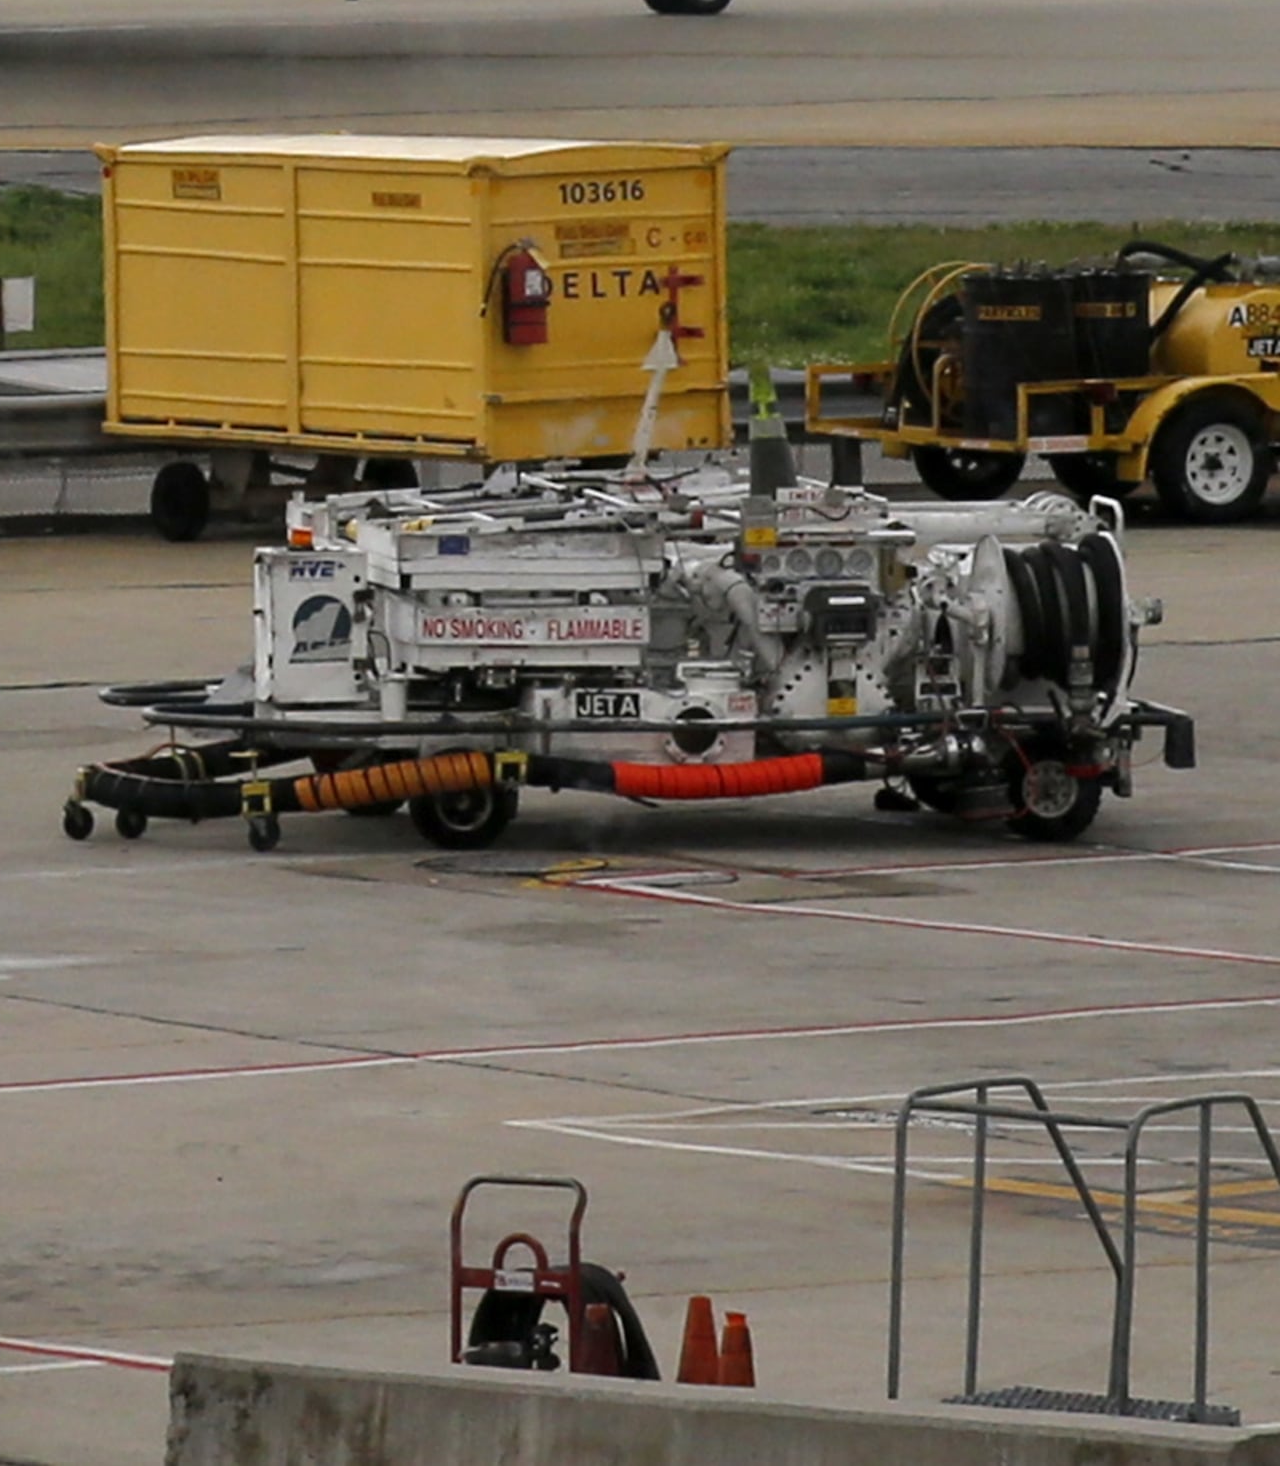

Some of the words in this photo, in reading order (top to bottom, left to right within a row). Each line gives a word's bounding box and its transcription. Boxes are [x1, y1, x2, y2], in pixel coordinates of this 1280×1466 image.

[559, 179, 645, 205] 103616
[423, 619, 446, 638] NO
[450, 618, 524, 639] SMOKING
[547, 619, 643, 640] FLAMMABLE
[579, 694, 617, 716] JET
[621, 696, 638, 715] A
